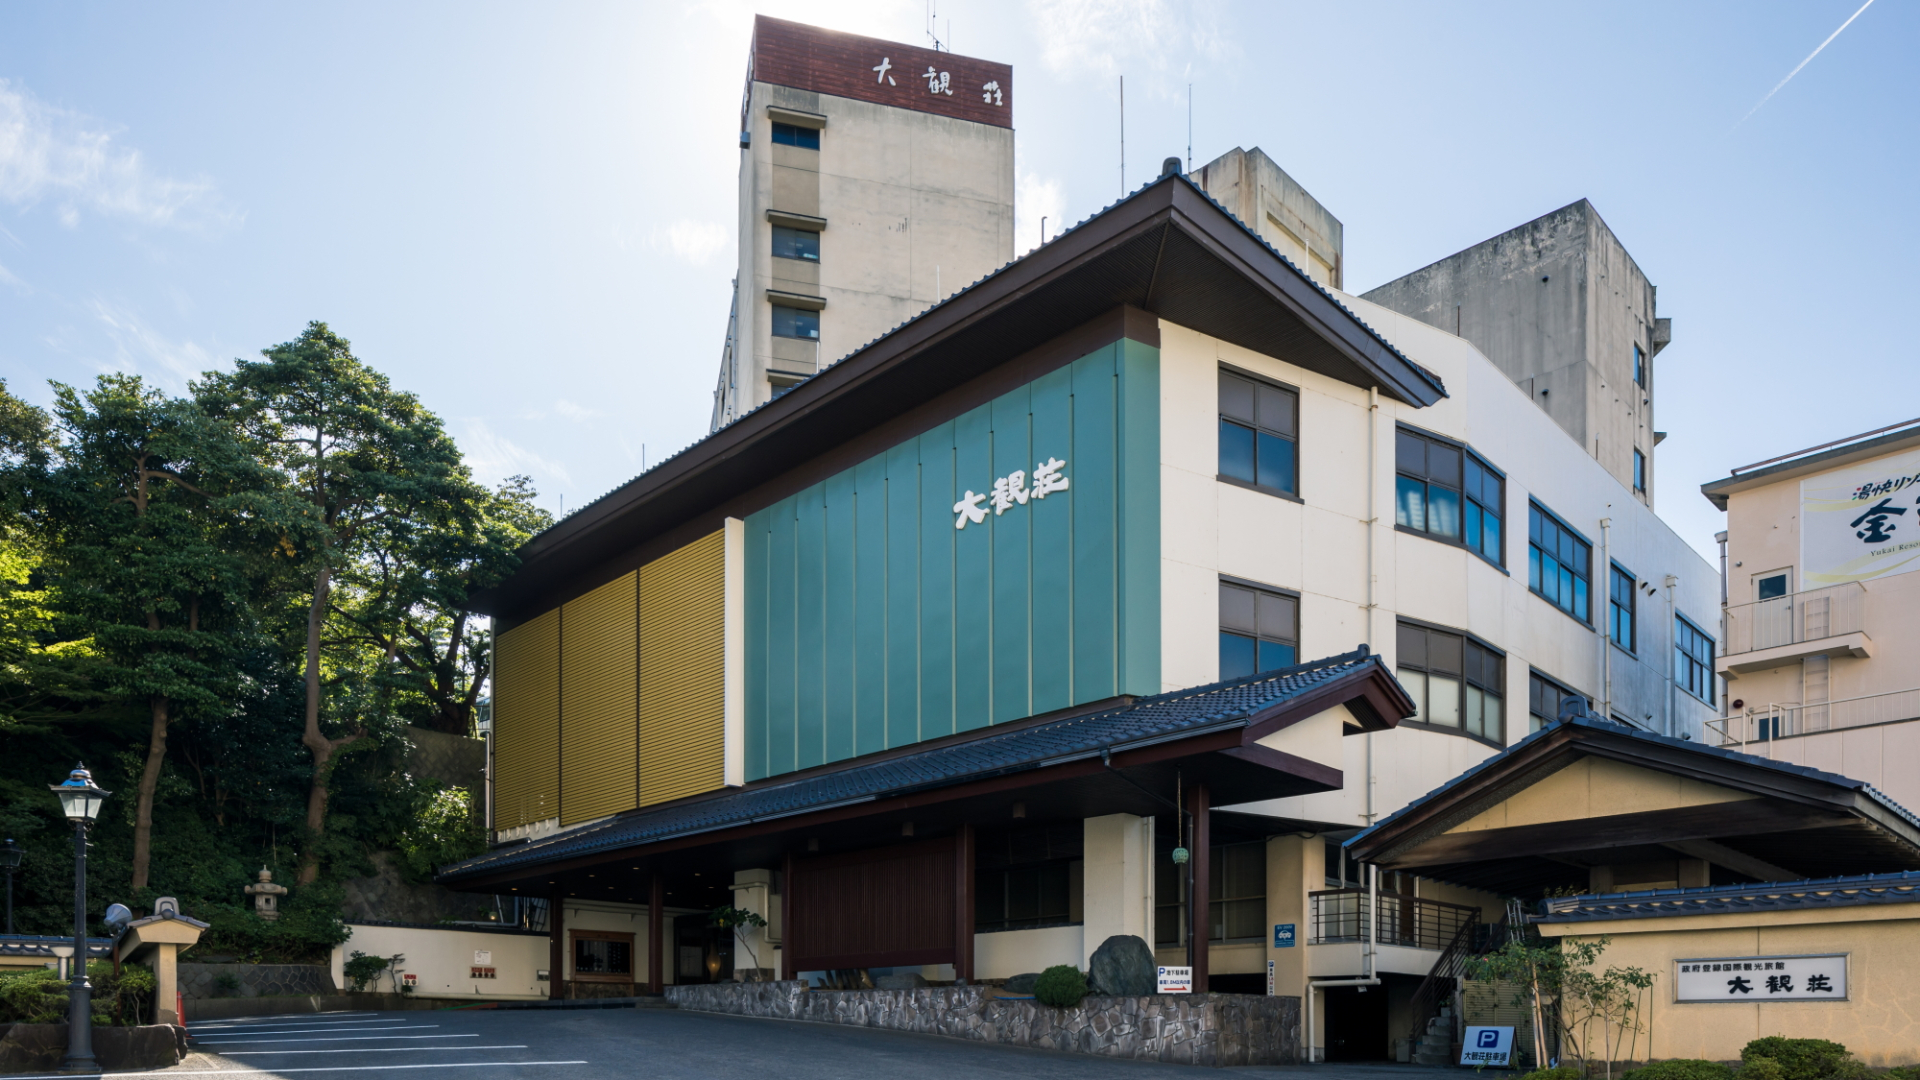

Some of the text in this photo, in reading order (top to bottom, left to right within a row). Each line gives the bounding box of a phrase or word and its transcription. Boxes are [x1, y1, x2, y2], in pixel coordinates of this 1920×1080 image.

[872, 57, 1003, 106] 大観荘
[953, 456, 1069, 530] 大観荘
[1852, 472, 1920, 500] 湯快リゾ
[1850, 495, 1920, 543] 金
[1870, 541, 1920, 557] Yukai Reso
[1681, 961, 1785, 973] 政府登録国際観光旅館
[1727, 974, 1833, 994] 大観荘
[1480, 1031, 1496, 1047] P
[1463, 1051, 1508, 1061] 大観荘駐車場
